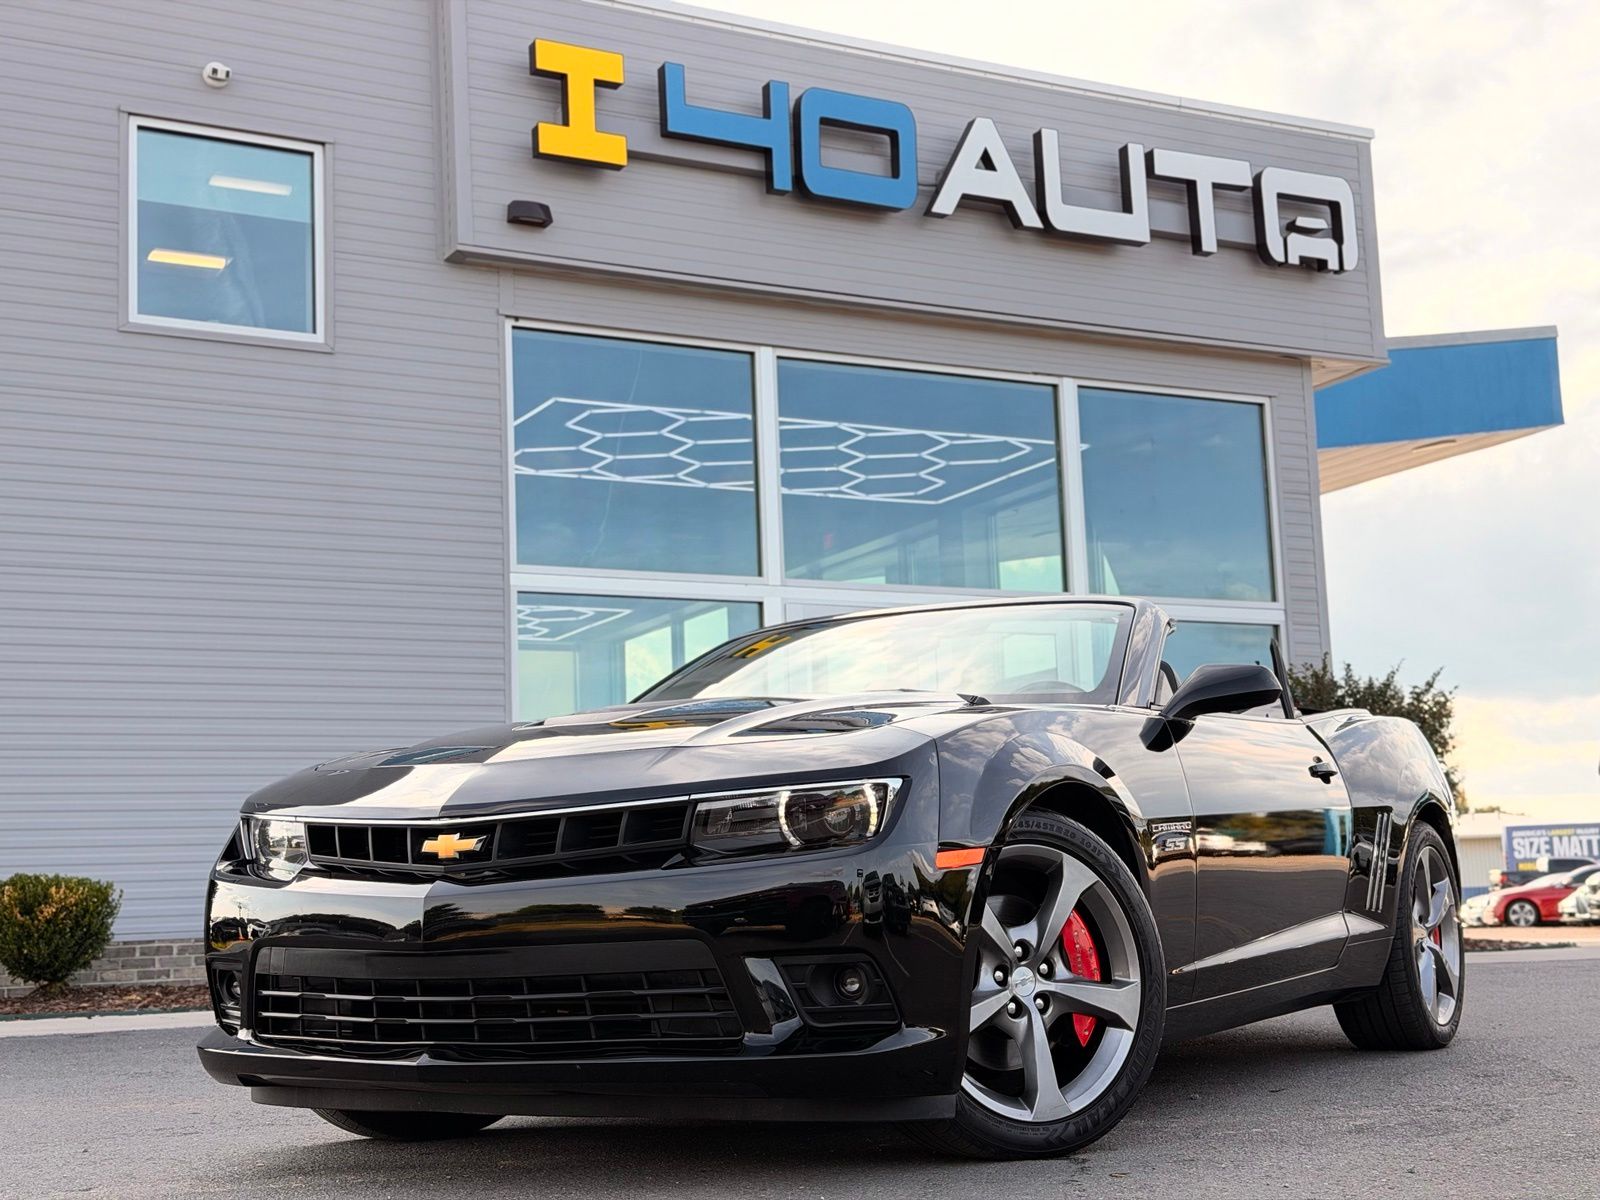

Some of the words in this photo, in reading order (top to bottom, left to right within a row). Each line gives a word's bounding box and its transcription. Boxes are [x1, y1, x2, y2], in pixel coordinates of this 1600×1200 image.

[923, 116, 1360, 275] AUTO
[1164, 836, 1188, 852] SS
[1512, 836, 1551, 859] SIZE
[1552, 835, 1600, 857] MATT
